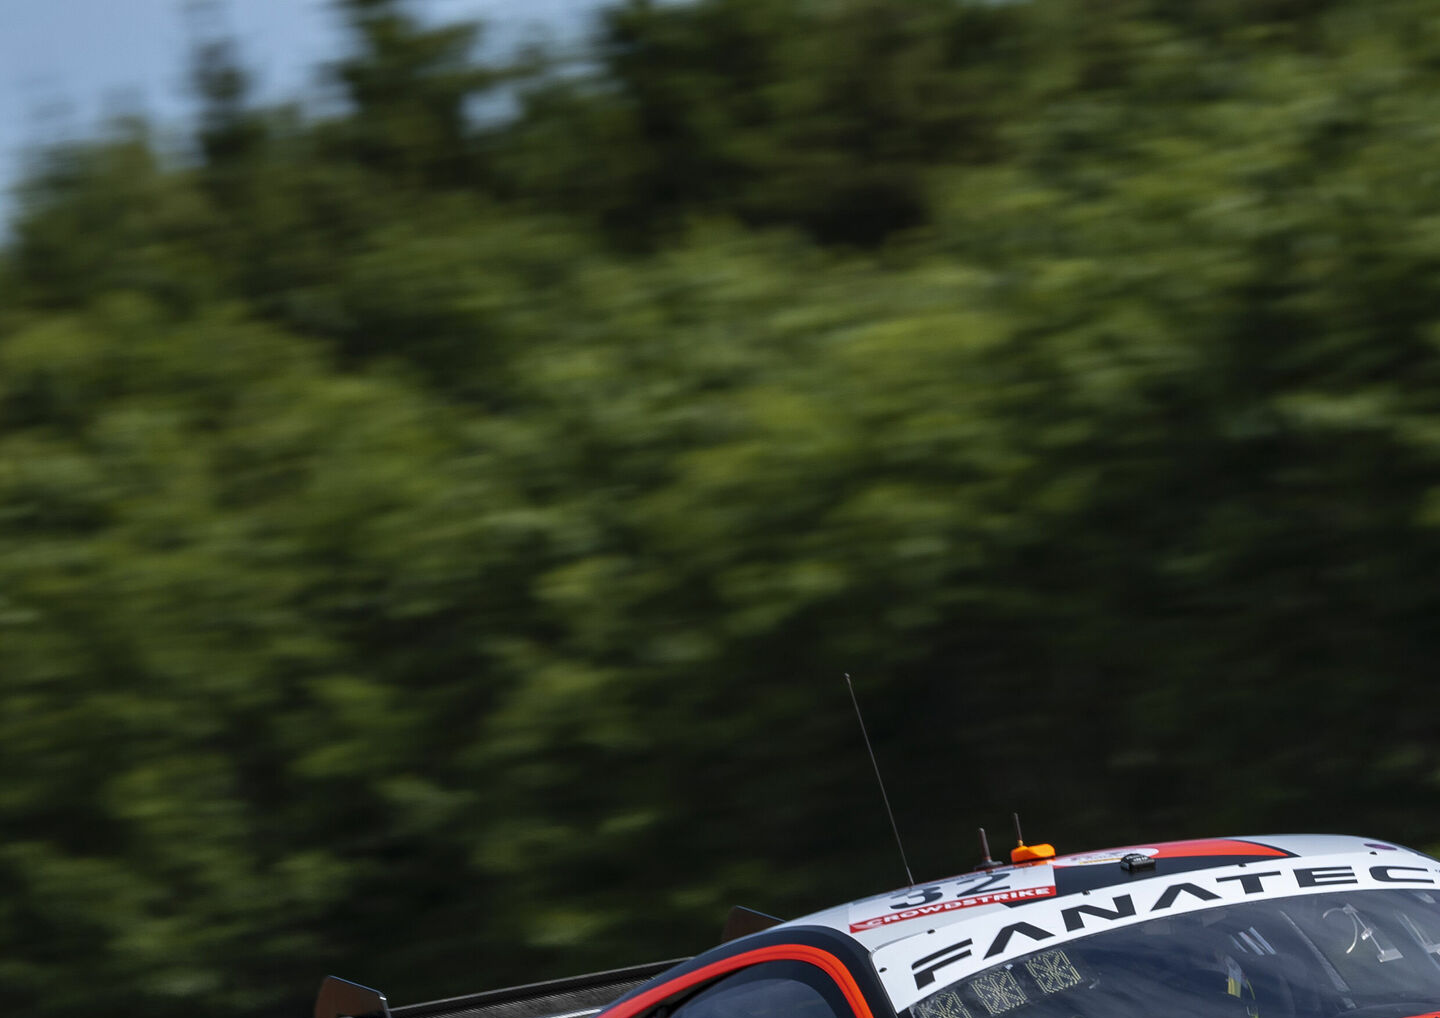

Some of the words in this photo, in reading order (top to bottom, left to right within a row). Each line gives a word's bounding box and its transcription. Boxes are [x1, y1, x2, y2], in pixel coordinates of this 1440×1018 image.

[862, 887, 1052, 929] CROWDSTRIKE
[890, 872, 1011, 911] 32
[910, 865, 1435, 990] FANATEC
